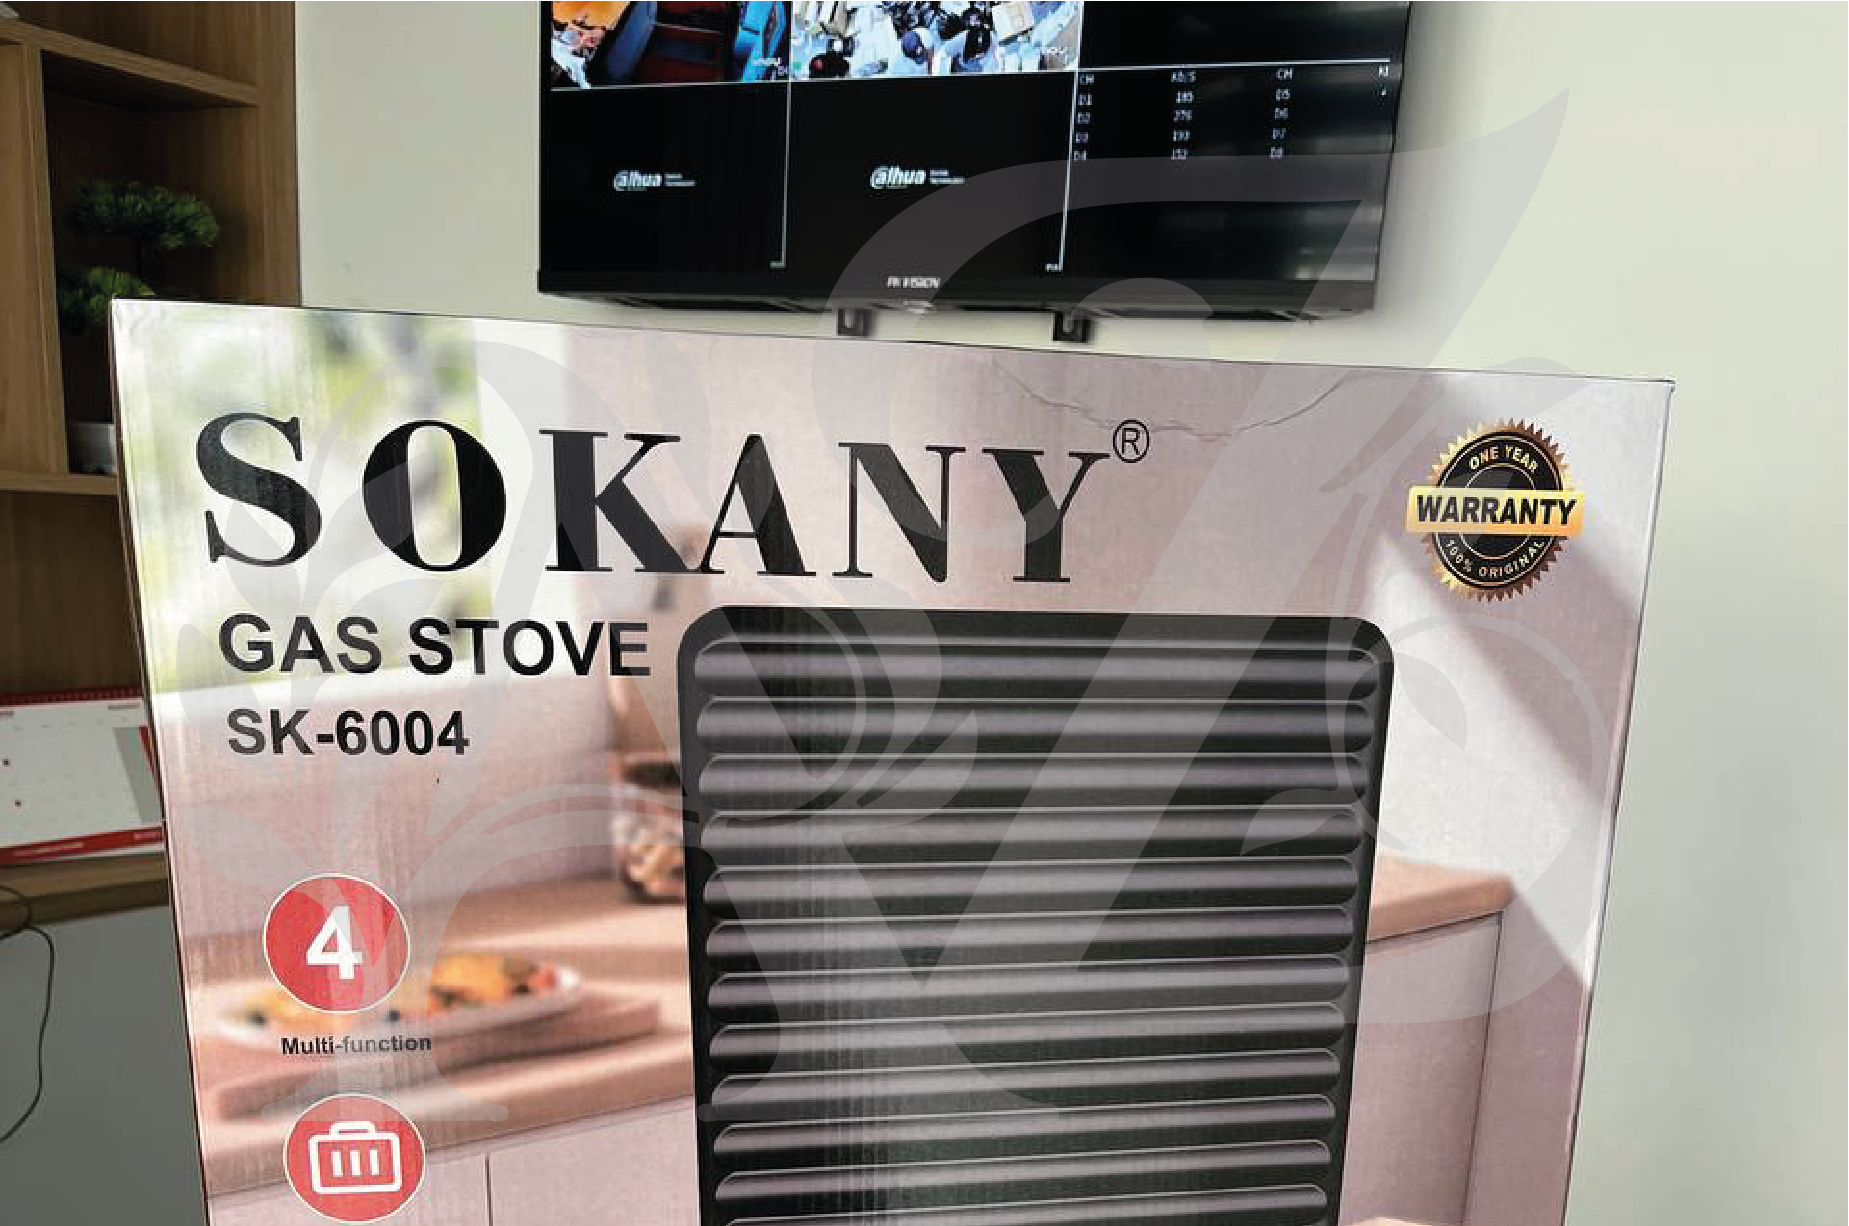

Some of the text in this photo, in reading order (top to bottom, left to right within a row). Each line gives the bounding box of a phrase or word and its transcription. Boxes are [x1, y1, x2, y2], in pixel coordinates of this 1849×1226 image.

[1469, 446, 1538, 472] ONE YEAR
[197, 412, 1110, 583] SOKANY
[1416, 494, 1577, 525] WARRANTY
[1446, 539, 1545, 578] 100% ORIGINAL
[219, 613, 650, 676] GAS STOVE
[228, 708, 470, 755] SK-6004
[306, 905, 362, 980] 4
[281, 1036, 432, 1055] Multi-function
